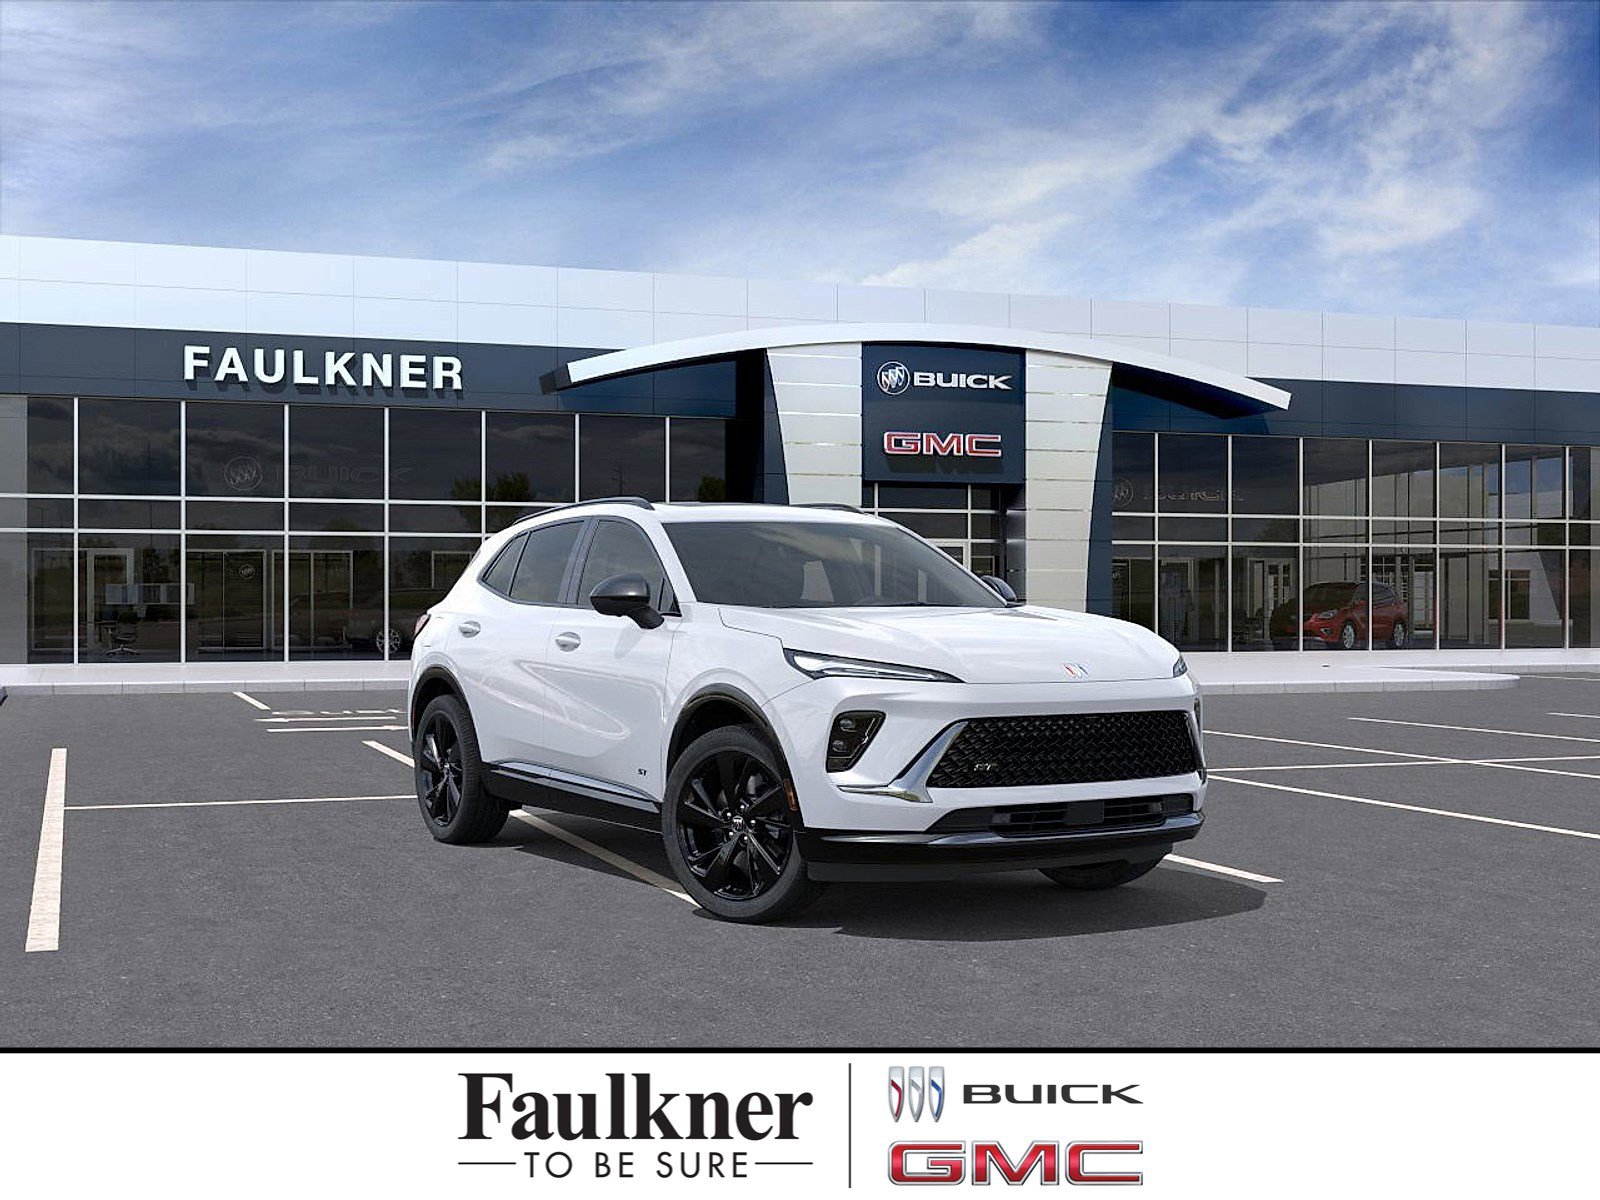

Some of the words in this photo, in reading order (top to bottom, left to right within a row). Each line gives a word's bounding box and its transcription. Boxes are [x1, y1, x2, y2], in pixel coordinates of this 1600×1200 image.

[183, 345, 463, 390] FAULKNER
[913, 371, 1013, 390] BUICK
[884, 431, 1002, 457] GMC
